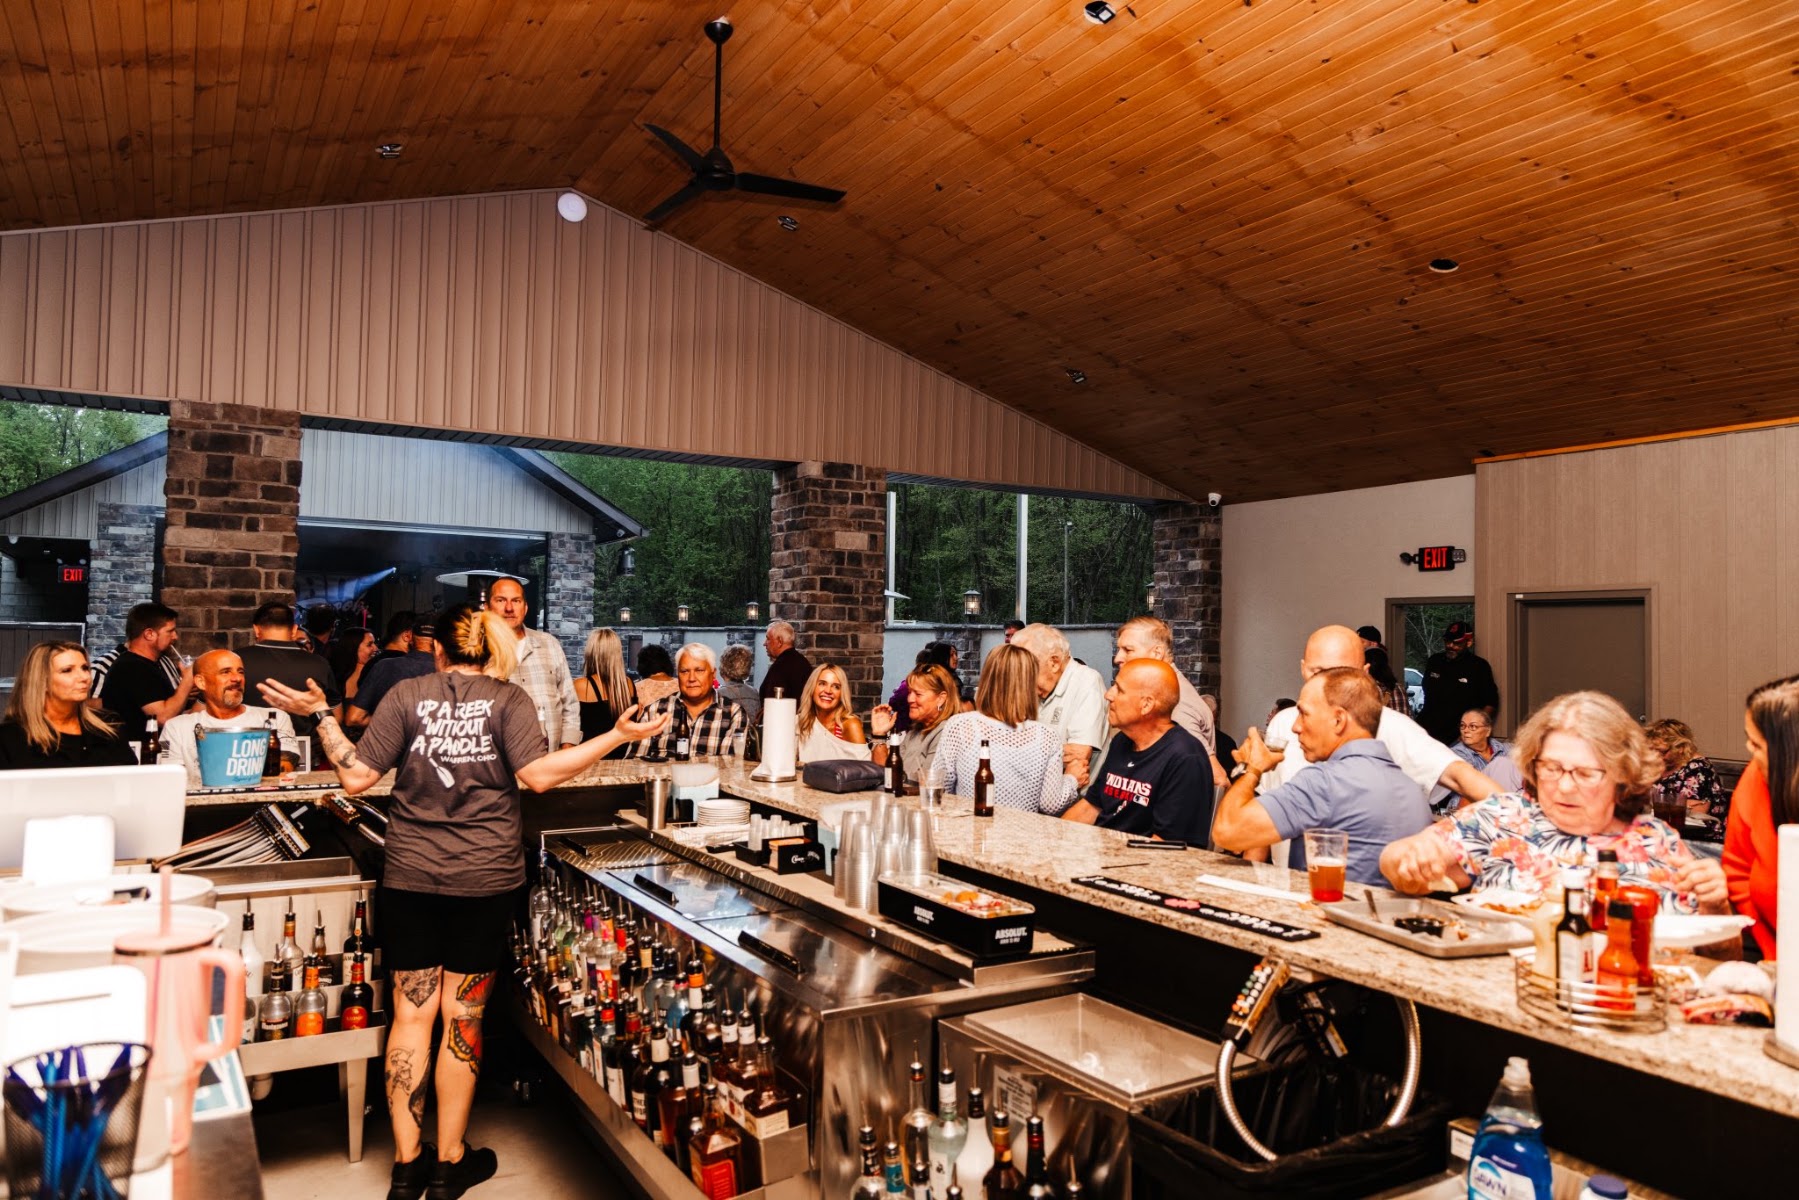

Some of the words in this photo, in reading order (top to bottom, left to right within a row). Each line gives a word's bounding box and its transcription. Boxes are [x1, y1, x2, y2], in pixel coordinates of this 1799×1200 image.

[1424, 547, 1448, 568] EXIT
[63, 568, 83, 581] EXIT
[417, 699, 439, 718] UP
[437, 700, 453, 720] A
[455, 699, 495, 719] REEK
[231, 737, 267, 758] LONG
[410, 735, 427, 755] A
